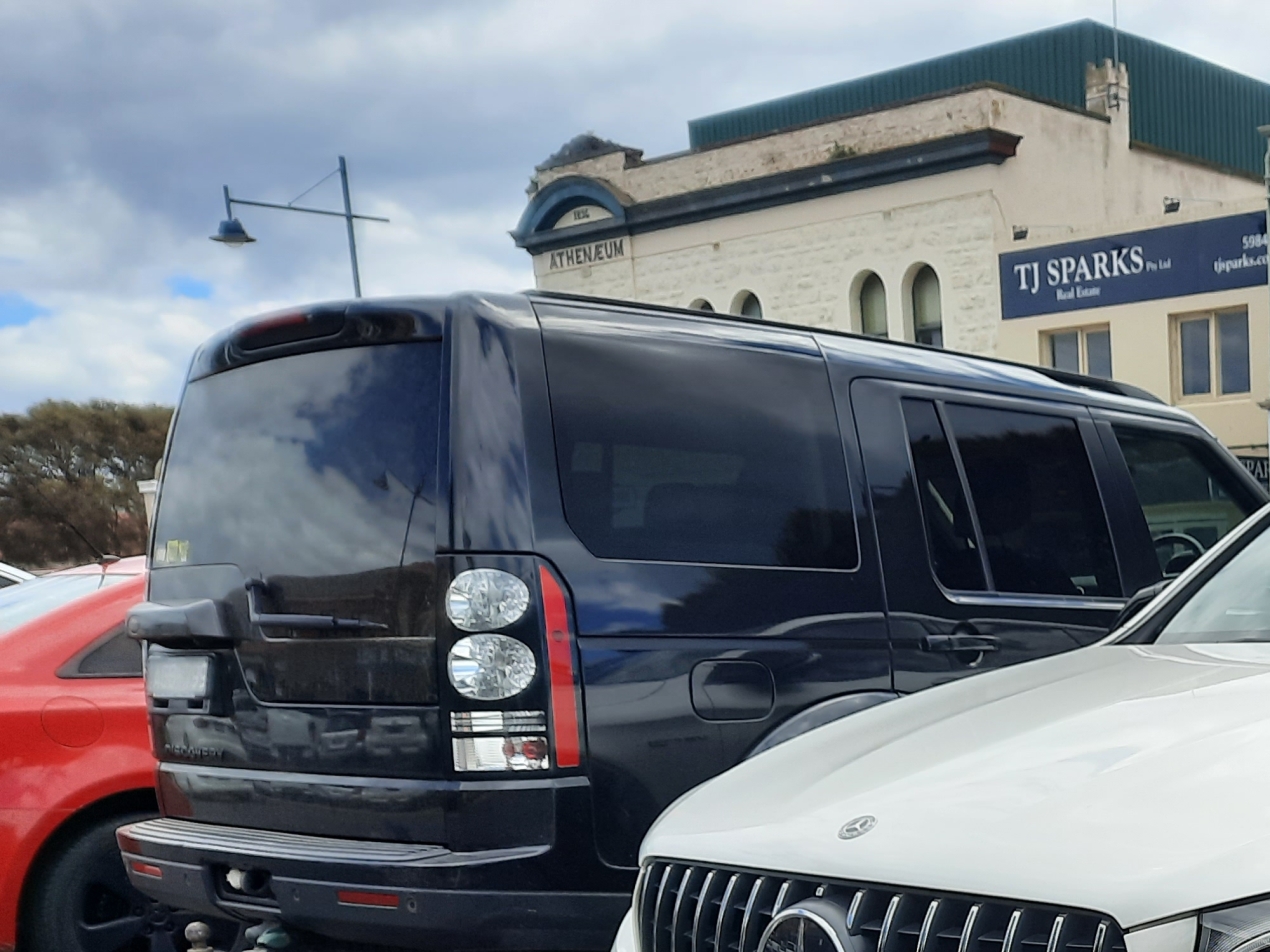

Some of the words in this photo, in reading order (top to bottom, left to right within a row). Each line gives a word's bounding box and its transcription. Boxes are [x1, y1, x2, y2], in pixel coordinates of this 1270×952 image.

[1014, 262, 1040, 294] TJ
[1047, 246, 1144, 286] SPARKS
[1056, 286, 1074, 301] Real
[1076, 286, 1101, 299] Estate
